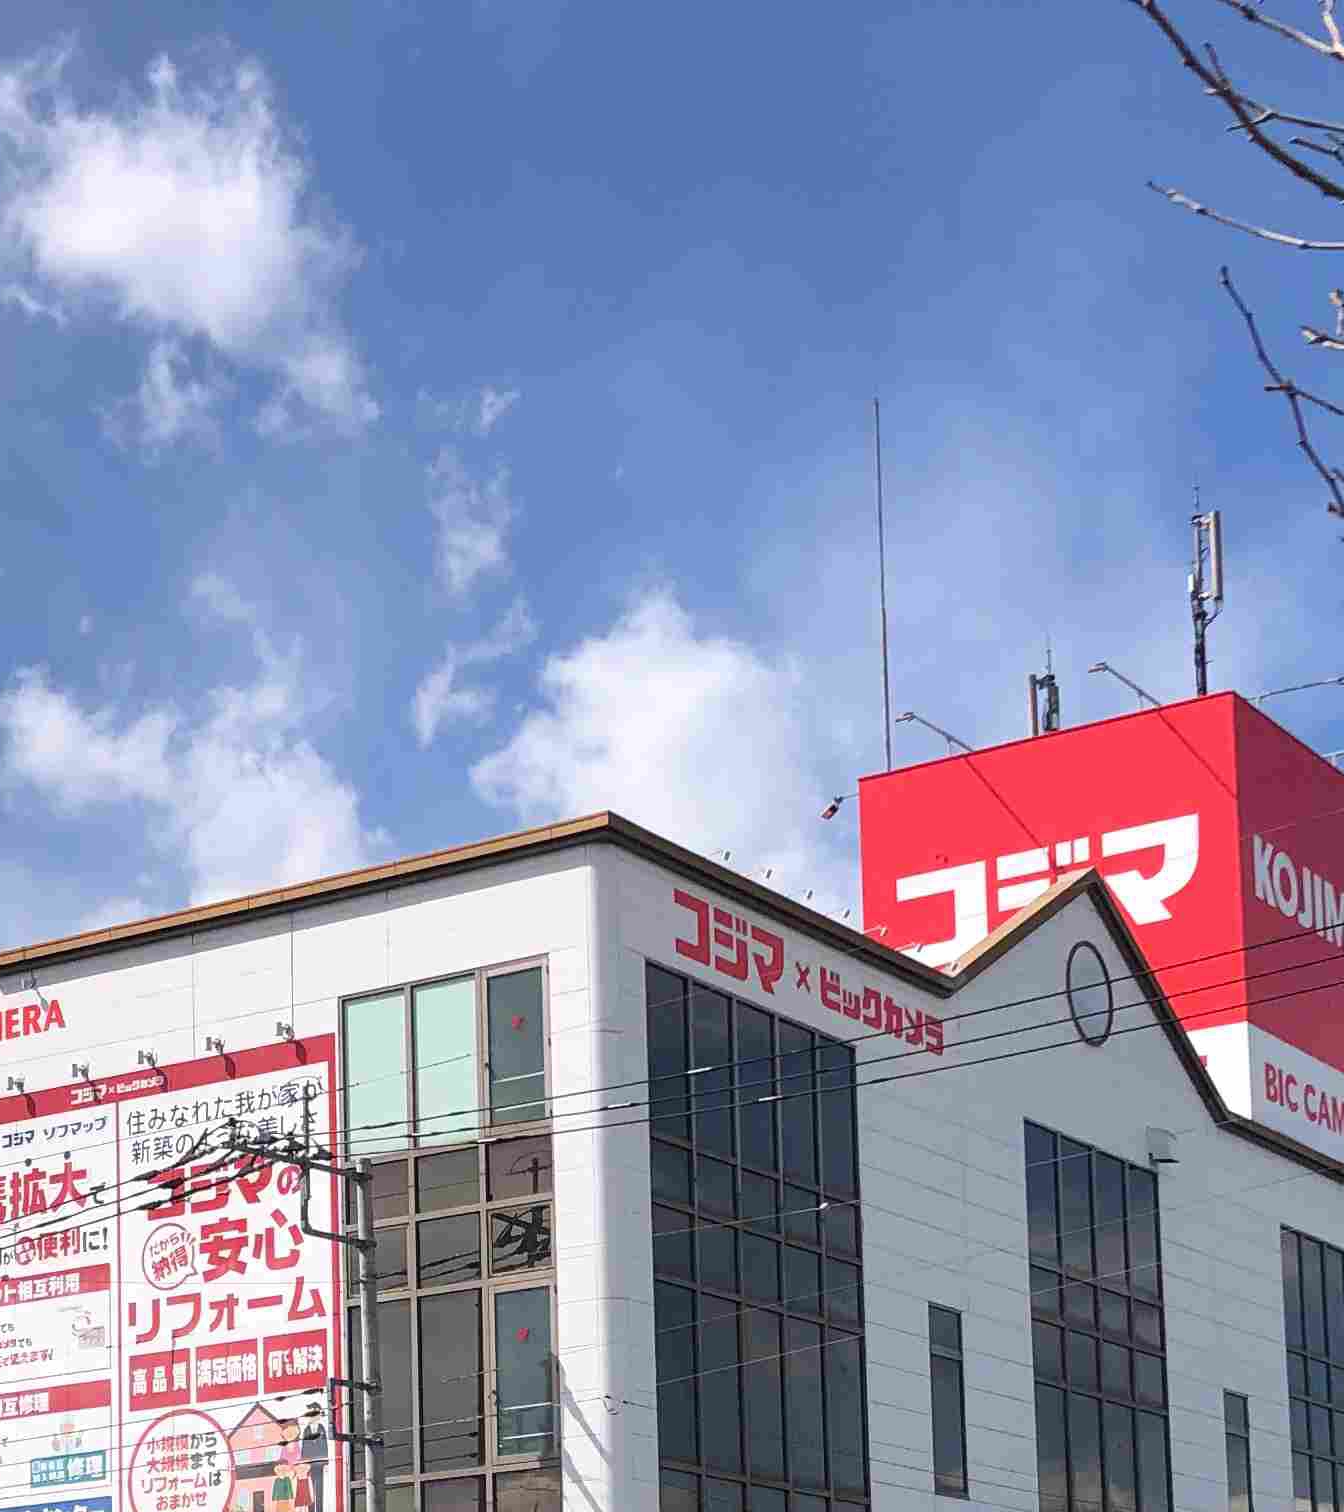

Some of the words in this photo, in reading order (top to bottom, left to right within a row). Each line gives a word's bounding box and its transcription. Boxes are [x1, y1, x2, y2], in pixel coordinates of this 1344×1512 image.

[1264, 1062, 1298, 1112] BIC
[1, 1130, 35, 1149] コジマ
[43, 1116, 107, 1140] ソフマップ
[199, 1208, 304, 1283] 安心
[128, 1276, 327, 1344] リフォーム
[132, 1361, 188, 1396] 高品質
[197, 1352, 256, 1387] 満足価格
[141, 1471, 223, 1494] リフォームは
[155, 1491, 207, 1510] おまかせ
